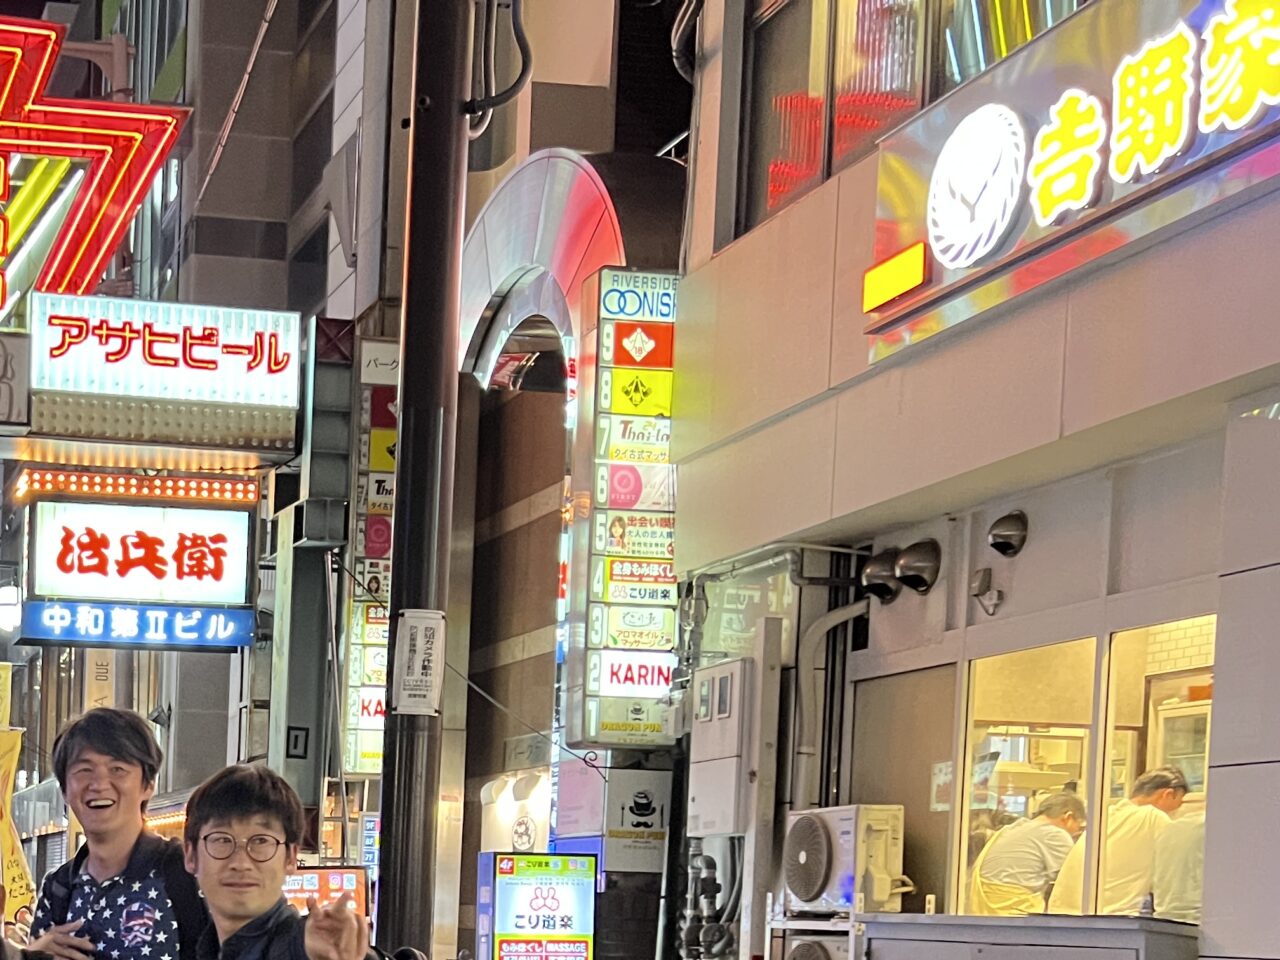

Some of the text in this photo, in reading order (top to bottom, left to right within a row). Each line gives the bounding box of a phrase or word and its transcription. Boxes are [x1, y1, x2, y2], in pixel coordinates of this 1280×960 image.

[612, 274, 677, 290] RIVERSIDE
[47, 314, 292, 374] アサヒビール
[602, 323, 614, 361] 9
[601, 371, 612, 409] 8
[599, 417, 611, 456] 7
[597, 466, 608, 503] 6
[595, 514, 607, 551] 5
[56, 525, 228, 582] 治兵衛
[612, 561, 674, 577] 全身もみほぐし
[593, 561, 604, 598] 4
[629, 587, 671, 600] こり道楽
[591, 606, 603, 645] 3
[616, 630, 659, 639] アロマオイル
[621, 638, 657, 648] マッサージ
[95, 660, 109, 682] DUE
[588, 654, 600, 691] 2
[610, 663, 671, 687] KARIN
[588, 701, 597, 737] 1
[500, 859, 513, 870] 4F
[514, 914, 574, 930] こり道楽
[545, 942, 587, 953] MASSAGE
